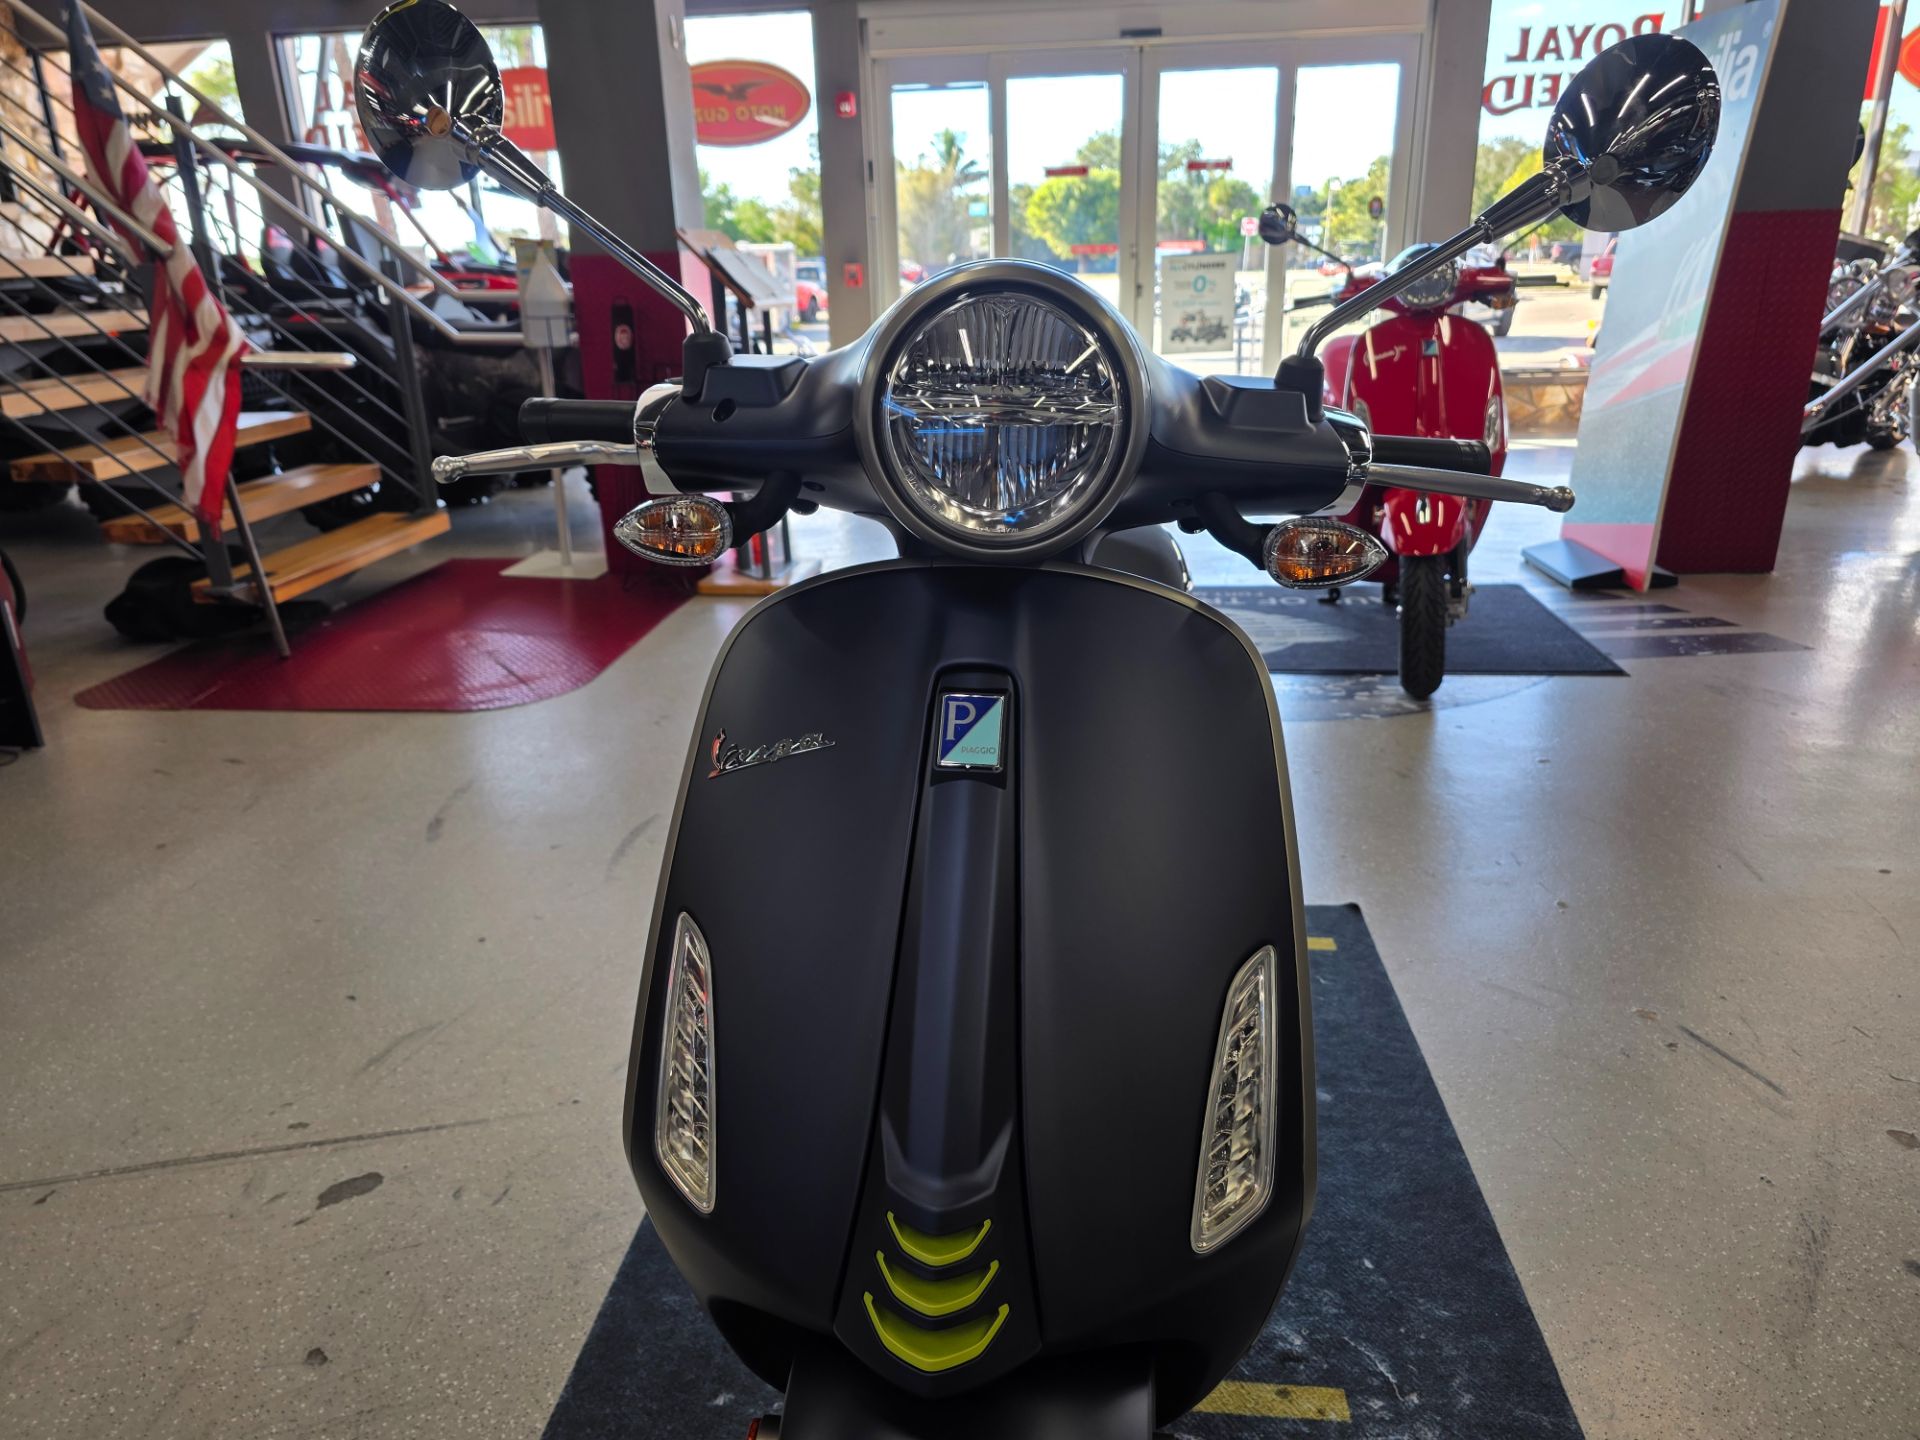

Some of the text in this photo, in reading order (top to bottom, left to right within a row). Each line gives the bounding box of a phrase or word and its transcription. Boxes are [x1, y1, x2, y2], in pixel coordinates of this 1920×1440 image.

[946, 701, 977, 741] P
[708, 728, 836, 779] Vespa
[961, 746, 997, 755] PIAGGIO
